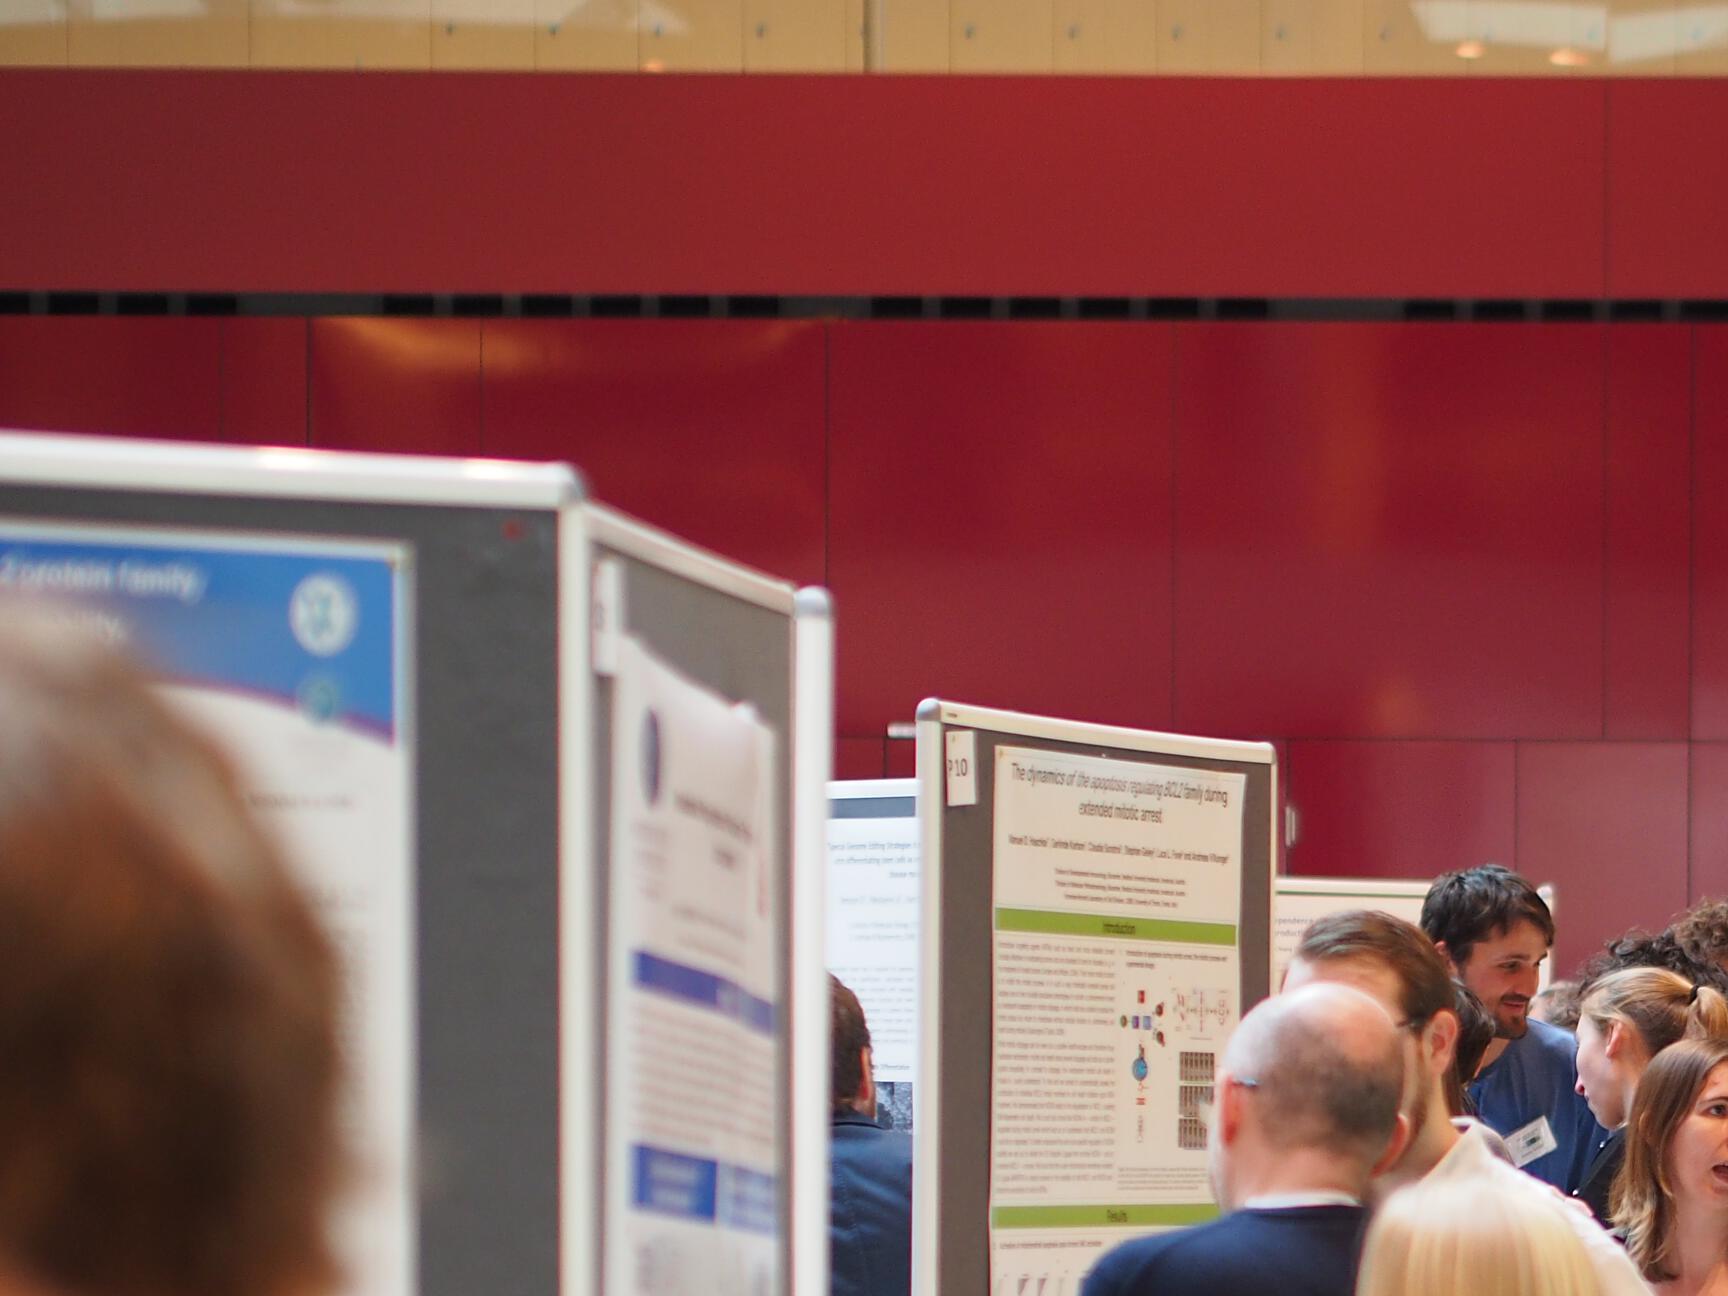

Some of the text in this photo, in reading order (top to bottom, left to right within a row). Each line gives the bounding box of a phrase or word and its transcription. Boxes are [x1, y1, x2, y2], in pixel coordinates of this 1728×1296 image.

[956, 758, 968, 777] 10
[1012, 763, 1025, 781] The
[1027, 764, 1065, 787] dynamics
[1076, 771, 1090, 789] the
[1091, 776, 1128, 795] apoptosis
[1128, 779, 1163, 801] regulating
[1183, 783, 1204, 806] family
[1204, 785, 1229, 808] during
[1079, 801, 1162, 824] extended mitotic arrest
